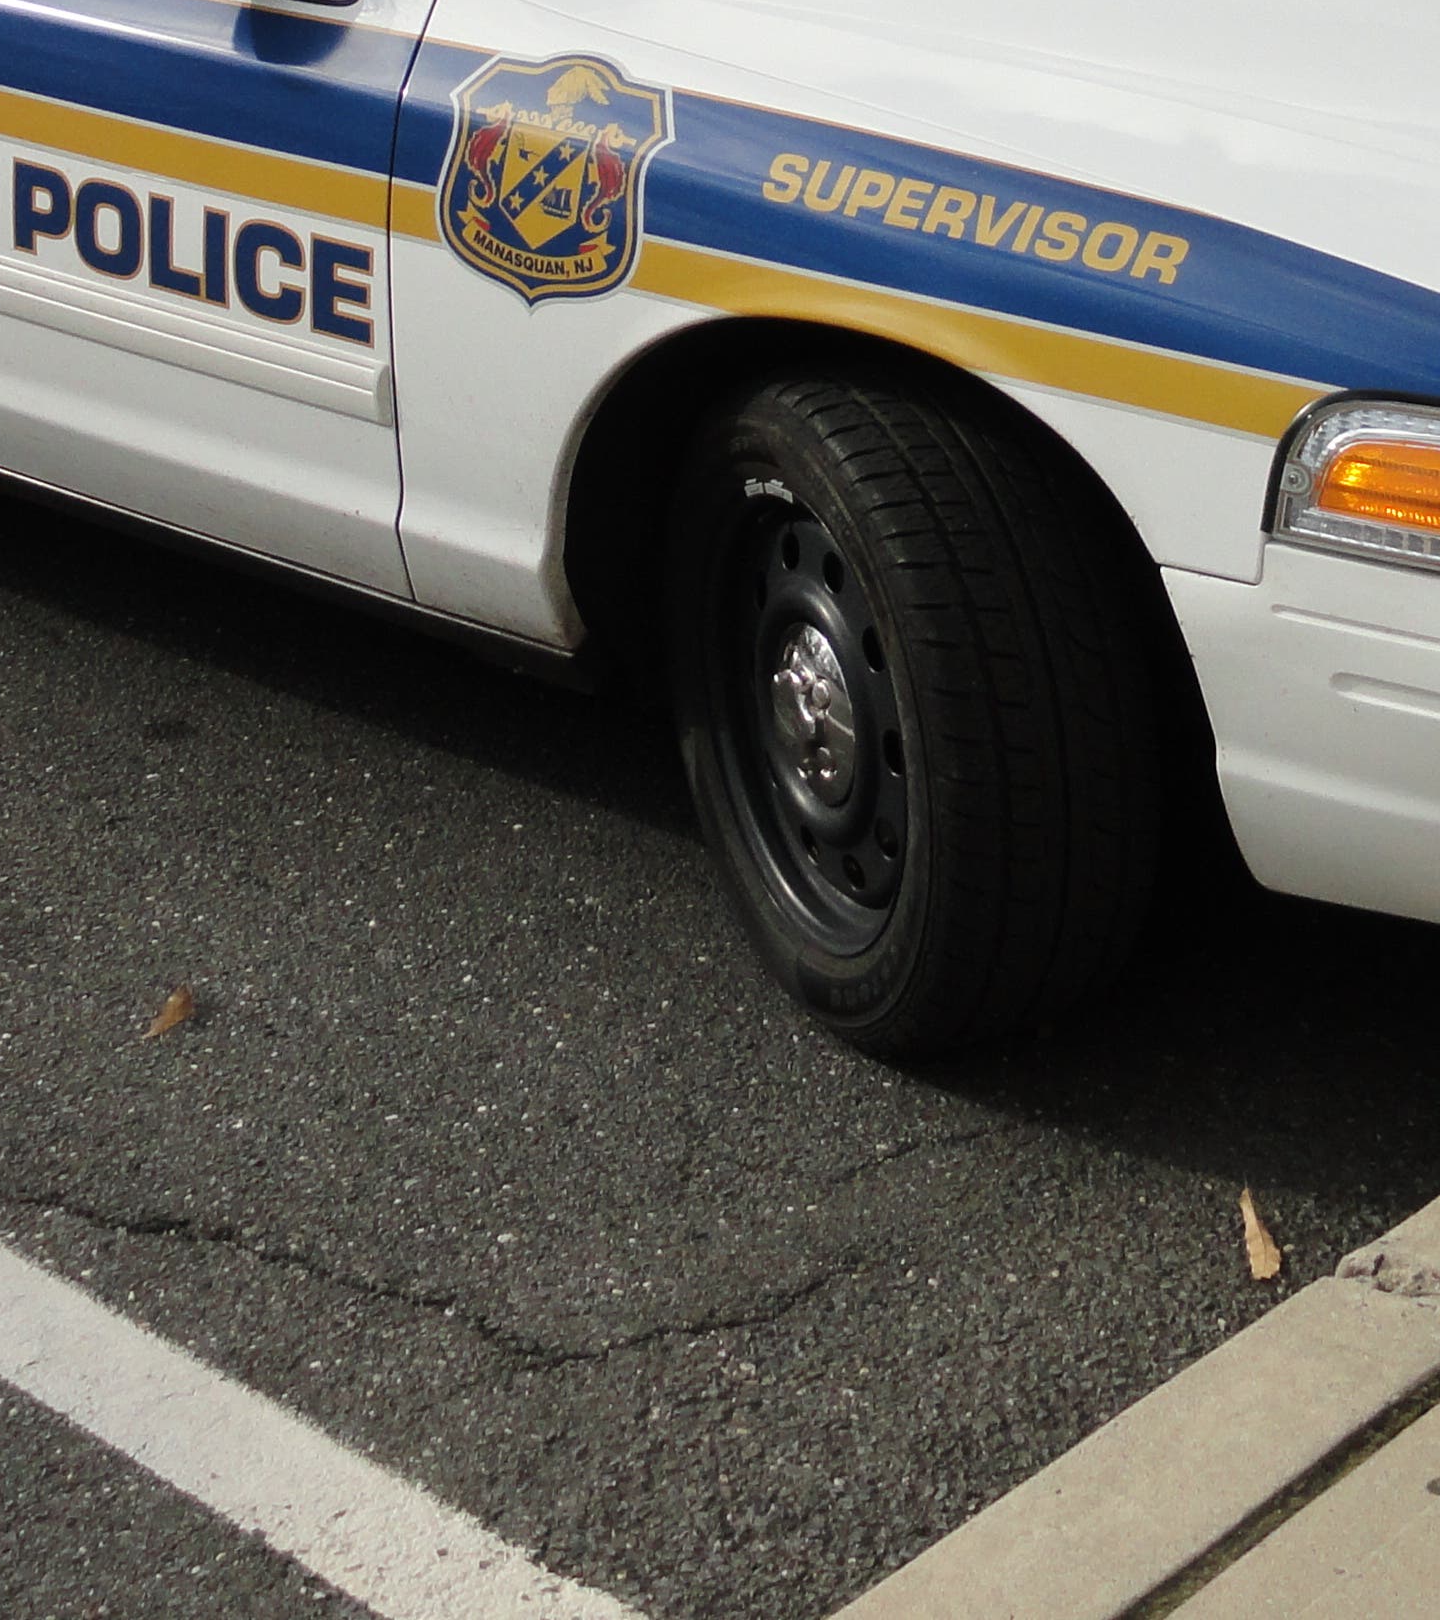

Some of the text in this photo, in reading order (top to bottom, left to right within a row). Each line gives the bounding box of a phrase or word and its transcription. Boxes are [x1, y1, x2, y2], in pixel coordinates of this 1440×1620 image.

[13, 155, 374, 348] POLICE
[473, 230, 594, 277] MANASQUAN, NJ
[762, 153, 1190, 285] SUPERVISOR
